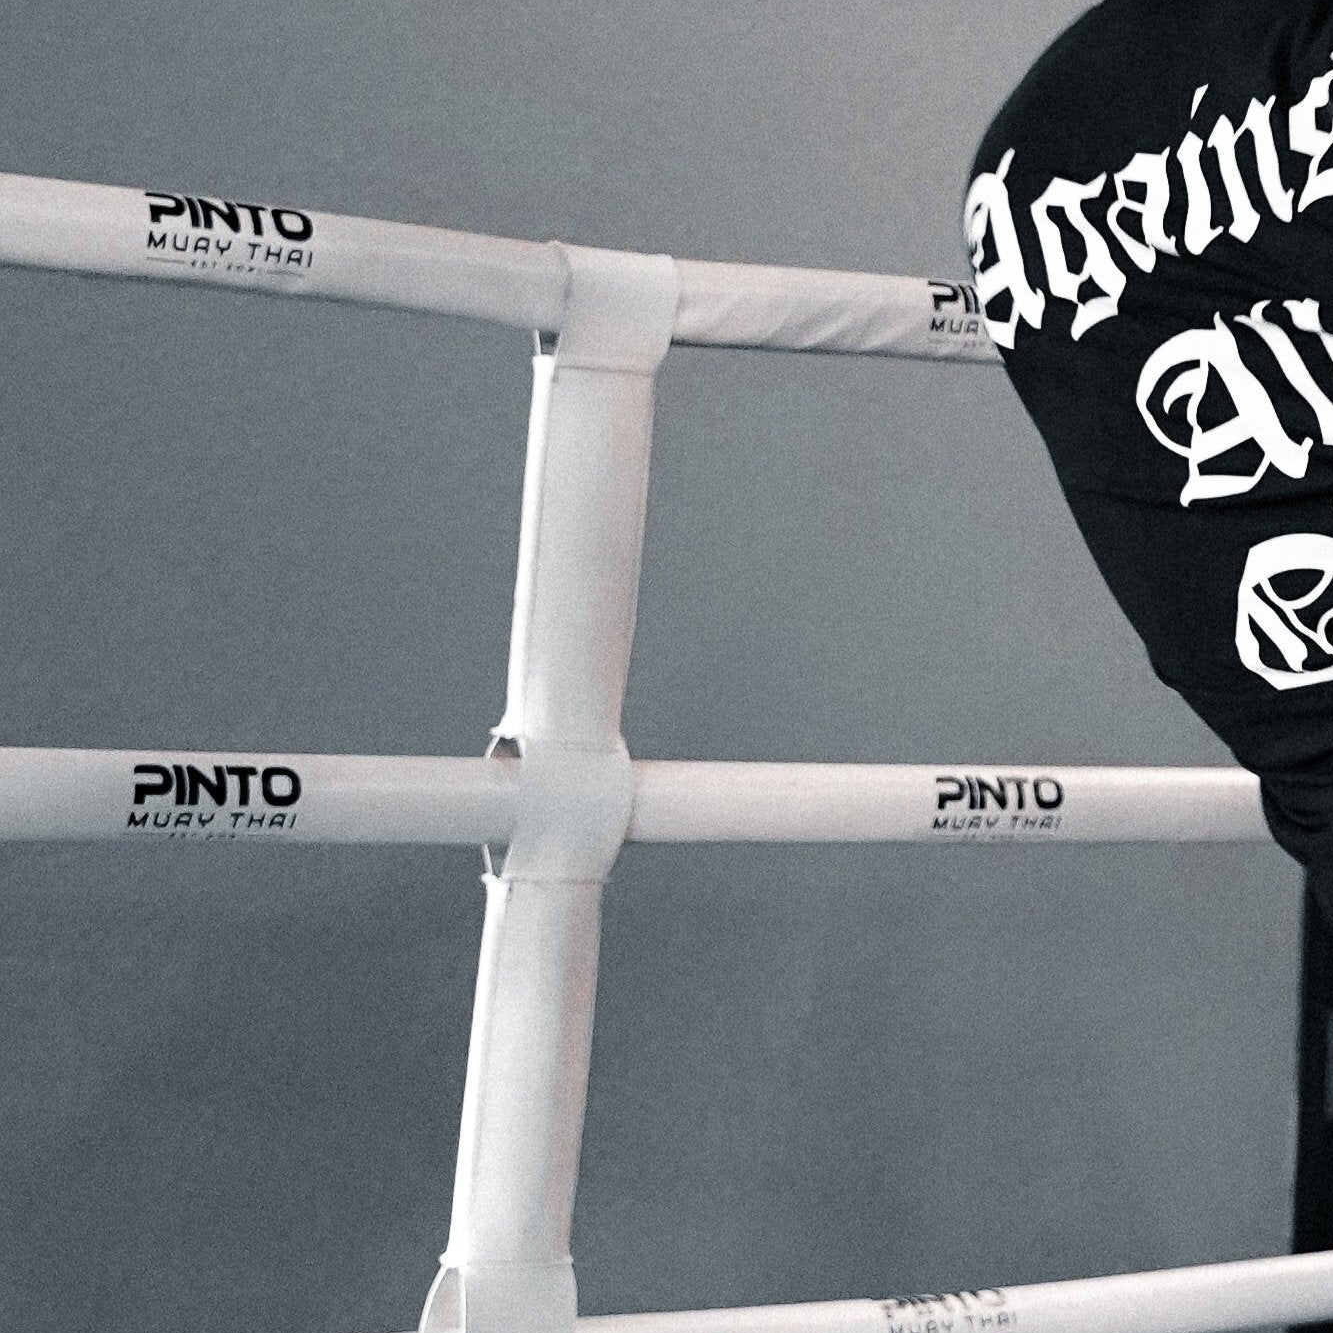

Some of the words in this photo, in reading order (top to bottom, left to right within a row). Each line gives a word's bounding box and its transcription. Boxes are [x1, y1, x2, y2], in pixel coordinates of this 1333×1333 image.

[144, 191, 314, 243] PINTO
[146, 230, 232, 258] MUAY
[248, 242, 313, 268] THAI
[929, 317, 980, 335] MUA
[133, 763, 302, 808] PINTO
[935, 774, 1064, 810] PINTO
[126, 811, 216, 830] MUAY
[230, 811, 298, 830] THAI
